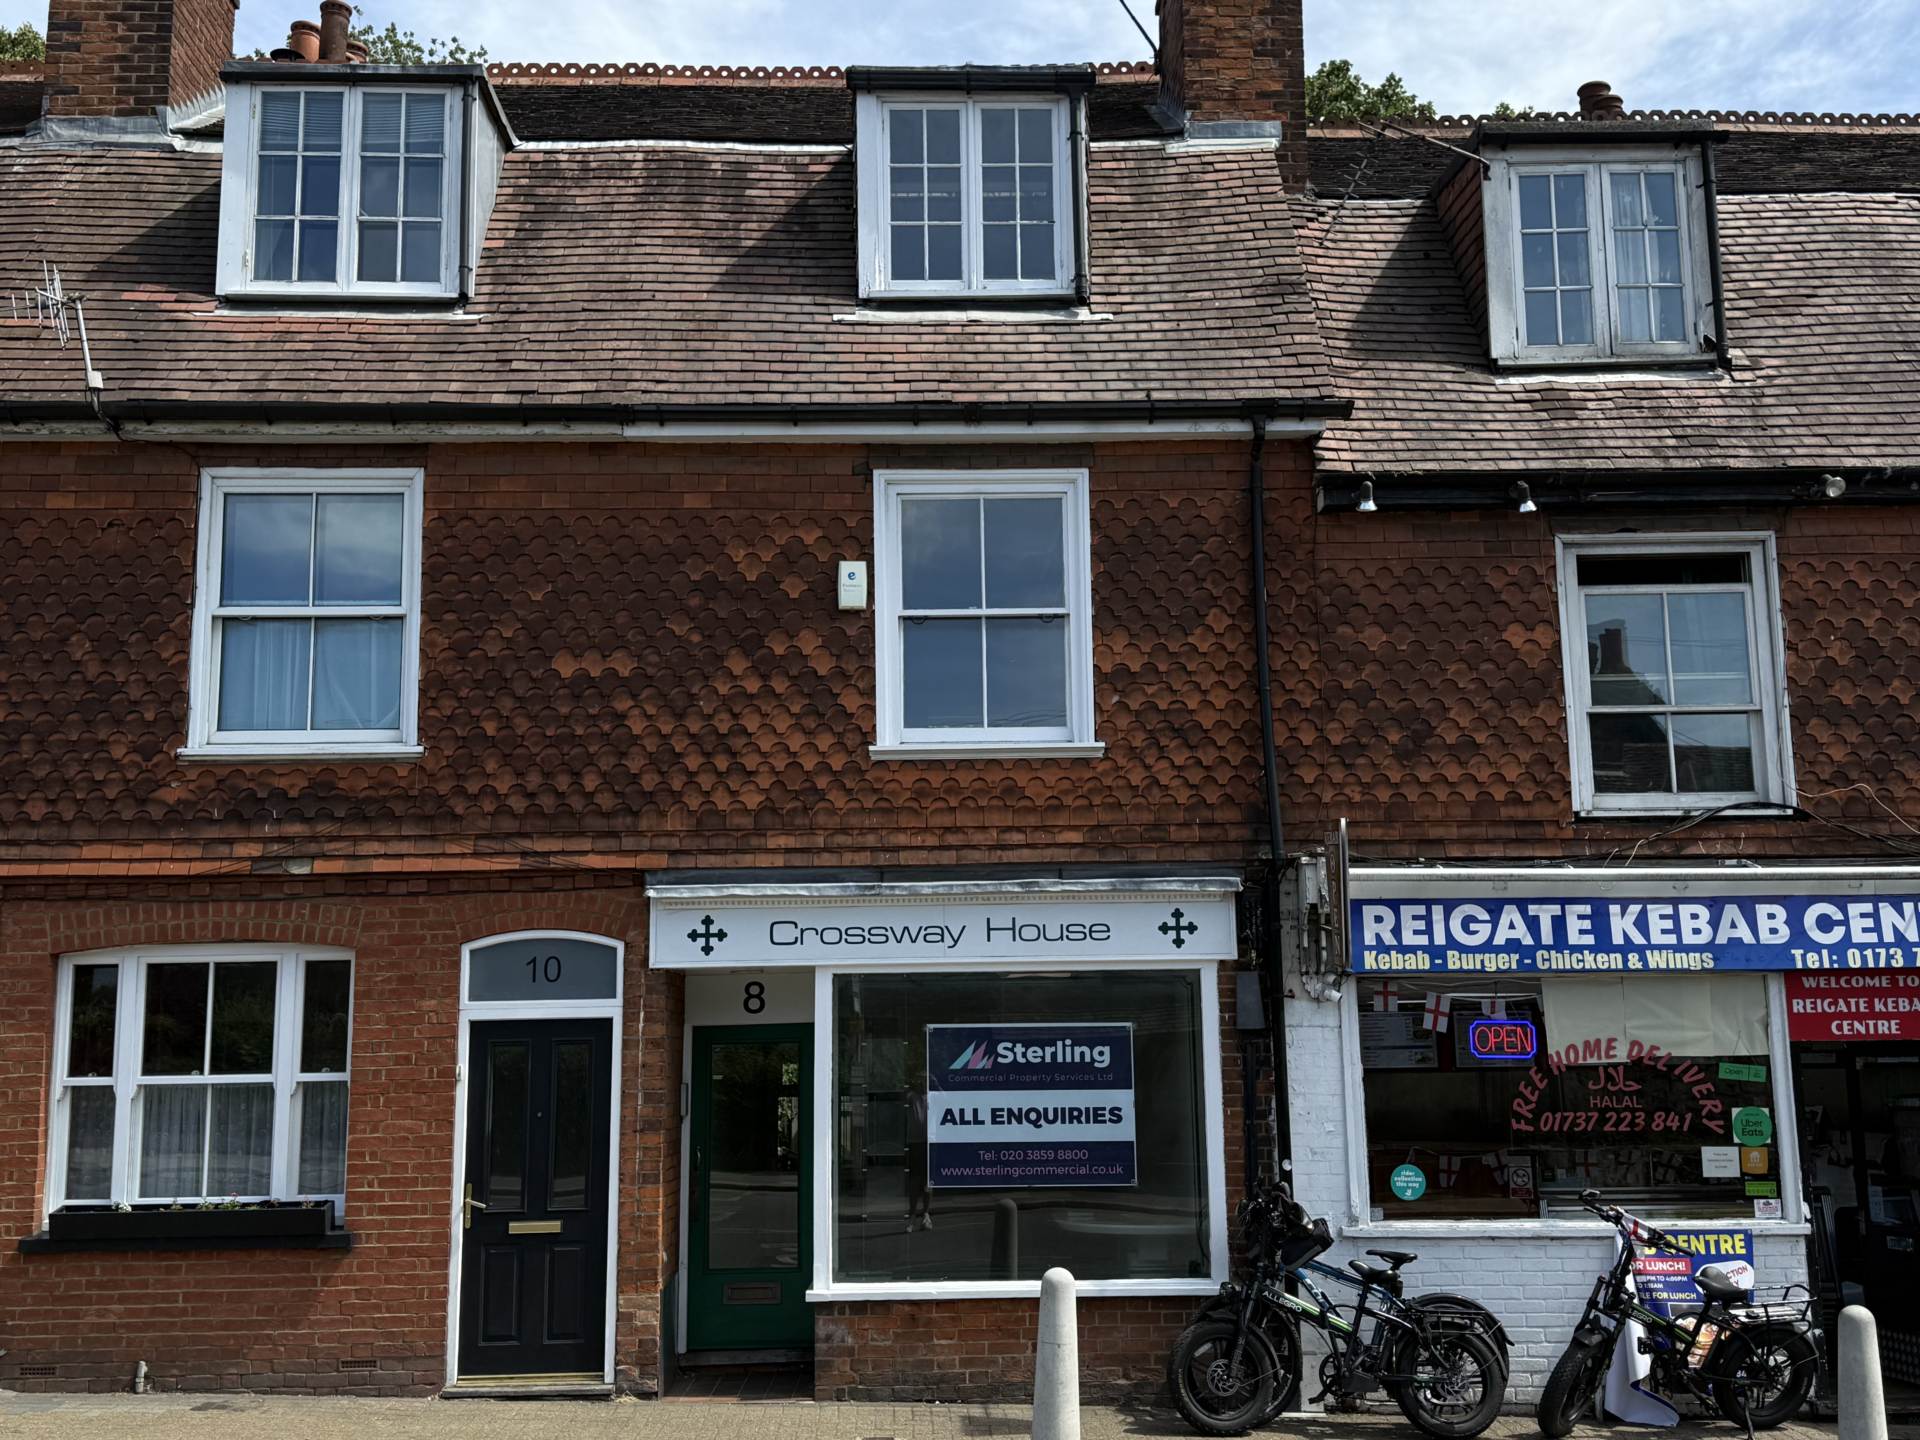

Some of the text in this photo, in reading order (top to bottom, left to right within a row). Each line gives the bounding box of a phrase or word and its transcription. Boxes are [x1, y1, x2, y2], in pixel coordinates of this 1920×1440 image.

[769, 916, 1111, 949] Crossway House
[1361, 902, 1920, 947] REIGATE KEBAB CEN
[525, 955, 561, 983] 10
[1363, 950, 1431, 971] Kebab
[1446, 950, 1520, 972] Burger
[1535, 949, 1624, 970] Chicken
[1627, 952, 1643, 969] &
[1645, 949, 1715, 971] Wings
[1790, 948, 1839, 969] Tel:
[1801, 975, 1920, 988] WELCOME TO
[742, 980, 766, 1015] 8
[1791, 997, 1870, 1013] REIGATE
[1830, 1019, 1902, 1035] CENTRE
[1474, 1026, 1532, 1053] OPEN
[996, 1039, 1111, 1068] Sterling
[947, 1072, 1113, 1083] Commercial Property Services Ltd
[1511, 1065, 1549, 1132] FREE
[1548, 1037, 1618, 1076] HOME
[1587, 1065, 1643, 1091] حلال
[1589, 1095, 1643, 1108] HALAL
[939, 1106, 1123, 1129] ALL ENQUIRIES
[1539, 1111, 1693, 1132] 01737 223 841
[1740, 1119, 1763, 1128] Uber
[1741, 1128, 1764, 1137] Eats
[978, 1149, 1089, 1161] Tel: 020 3859 8800
[940, 1163, 1124, 1178] www.sterlingcommercial.co.uk
[1646, 1261, 1687, 1271] LUNCH!
[1261, 1290, 1303, 1313] ALLEGRO
[1652, 1291, 1669, 1300] FOR
[1669, 1291, 1697, 1300] LUNCH
[1628, 1307, 1653, 1324] LEGRO
